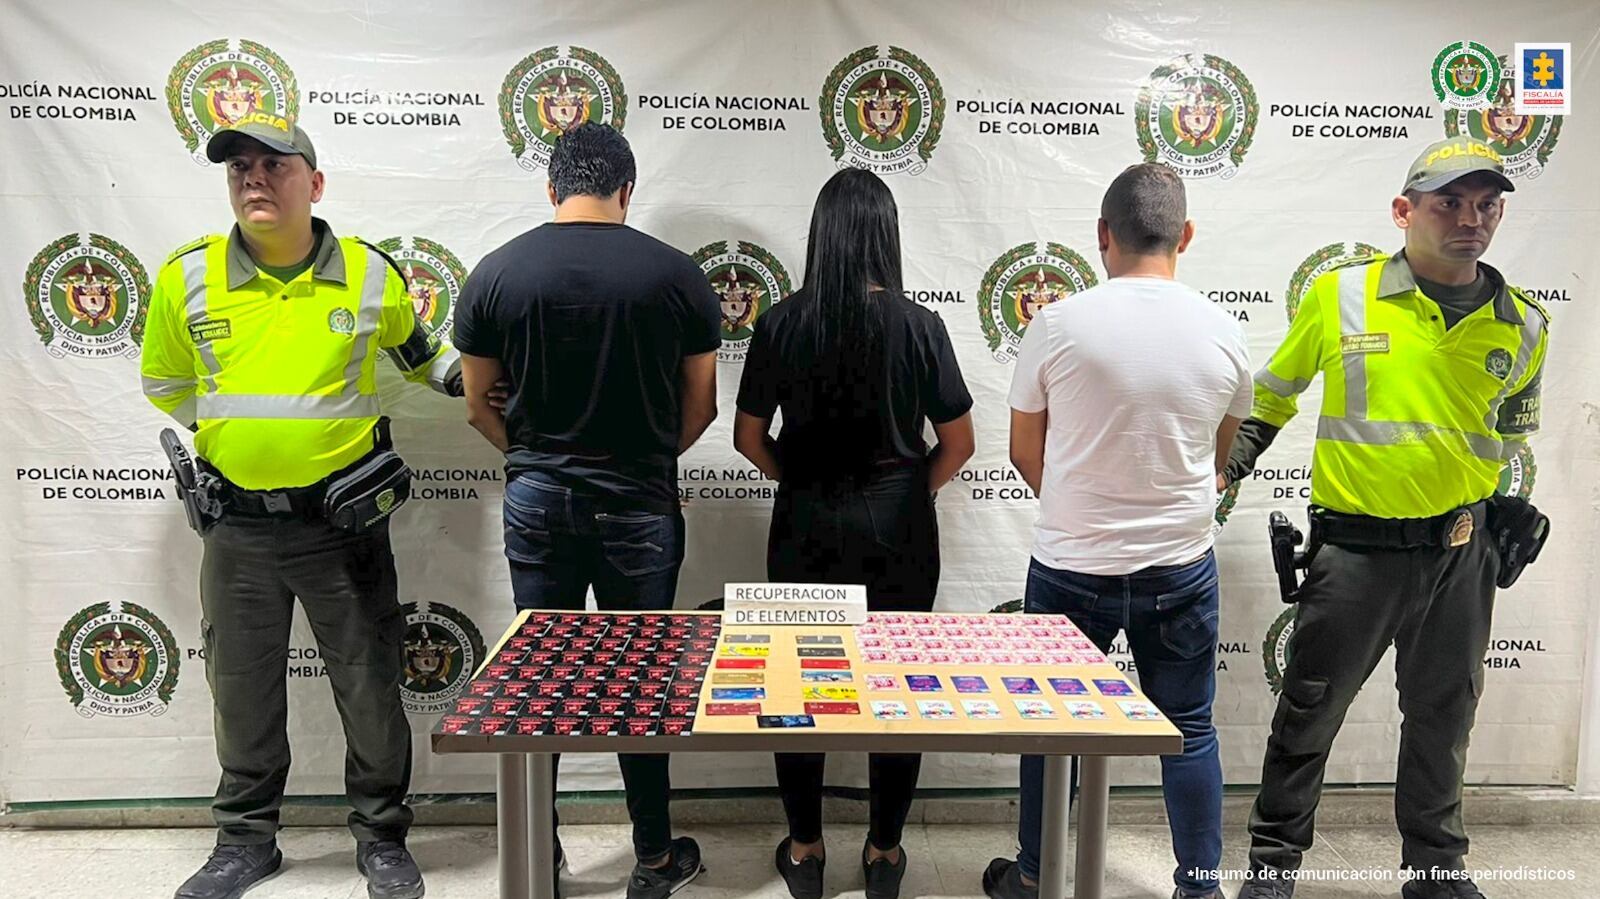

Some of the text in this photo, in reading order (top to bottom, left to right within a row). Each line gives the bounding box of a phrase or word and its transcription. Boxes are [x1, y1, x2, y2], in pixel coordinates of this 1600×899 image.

[0, 80, 156, 101] OLICÍA NACIONAL
[183, 56, 217, 108] REPUBLICA
[254, 59, 284, 110] COLOMBIA
[515, 65, 548, 114] REPUBLICA
[582, 64, 612, 114] COLOMBIA
[309, 88, 380, 104] POLICÍA
[836, 66, 868, 117] REPUBLICA
[902, 66, 930, 118] COLOMBIA
[1216, 73, 1244, 123] COLOMBIA
[638, 92, 810, 110] POLICÍA NACIONAL
[956, 99, 1124, 116] POLICÍA NACIONAL
[10, 106, 136, 121] DE COLOMBIA
[1270, 102, 1434, 119] POLICÍA NACIONAL
[334, 112, 461, 126] DE COLOMBIA
[663, 117, 786, 131] DE COLOMBIA
[192, 120, 210, 140] POLI
[979, 121, 1100, 136] DE COLOMBIA
[1292, 126, 1408, 138] DE COLOMBIA
[882, 130, 925, 160] NACIONAL
[1195, 132, 1238, 164] NACIONAL
[1506, 135, 1546, 164] NACIONAL
[532, 153, 549, 166] DIO
[882, 158, 913, 172] PATRIA
[1194, 162, 1224, 176] PATRIA
[40, 252, 73, 303] REPUBLICA
[104, 254, 136, 304] COLOMBIA
[750, 261, 778, 302] COLOMBI
[993, 261, 1026, 310] REPUBLICA
[1059, 262, 1085, 292] COLOM
[903, 291, 966, 302] IONAL
[1208, 291, 1273, 302] CIONAL
[1526, 290, 1572, 301] ONAL
[96, 315, 134, 344] NACIONAL
[998, 322, 1020, 344] POLICI
[96, 342, 128, 356] PATRIA
[16, 465, 174, 481] POLICÍA NACIONA
[724, 470, 764, 480] NACI
[953, 467, 1016, 482] OLICÍA
[1512, 460, 1520, 482] MBIA
[42, 486, 166, 500] DE COLOMBIA
[412, 488, 478, 500] LOMBIA
[700, 488, 776, 499] COLOMBI
[973, 488, 994, 500] DE
[1274, 488, 1294, 498] DE
[736, 588, 846, 600] RECUPERACION
[736, 610, 846, 622] DE ELEMENTOS
[72, 620, 101, 667] REPUBLICA
[134, 620, 166, 665] COLOMBIA
[442, 620, 472, 664] COLOMBIA
[1277, 624, 1294, 658] REPUBL
[1492, 640, 1546, 652] IONAL
[1483, 658, 1520, 668] MBIA
[288, 666, 328, 678] MBIA
[122, 675, 162, 703] NACIONAL
[122, 702, 154, 714] PATRIA
